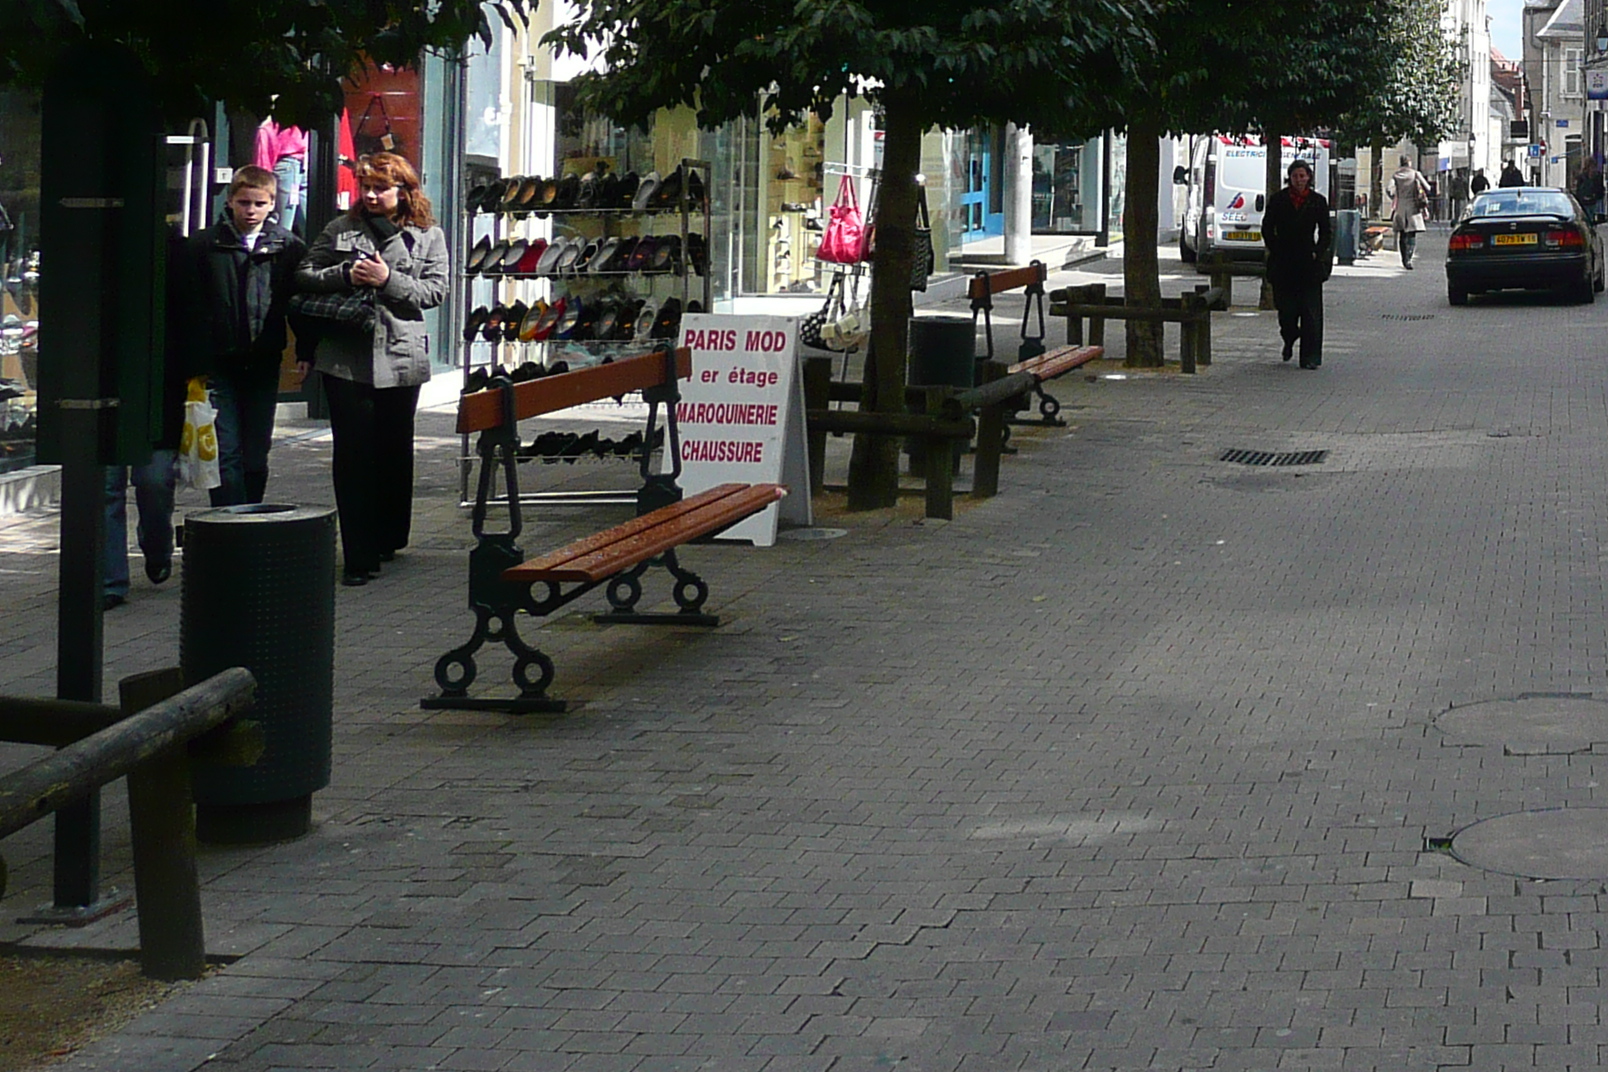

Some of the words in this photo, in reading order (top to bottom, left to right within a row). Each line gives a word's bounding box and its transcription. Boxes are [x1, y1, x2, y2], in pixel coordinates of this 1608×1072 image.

[684, 330, 736, 351] PARIS
[745, 331, 786, 352] MOD
[701, 369, 719, 383] er
[728, 366, 778, 387] étage
[677, 403, 777, 425] MAROQUINERIE
[682, 441, 763, 462] CHAUSSURE
